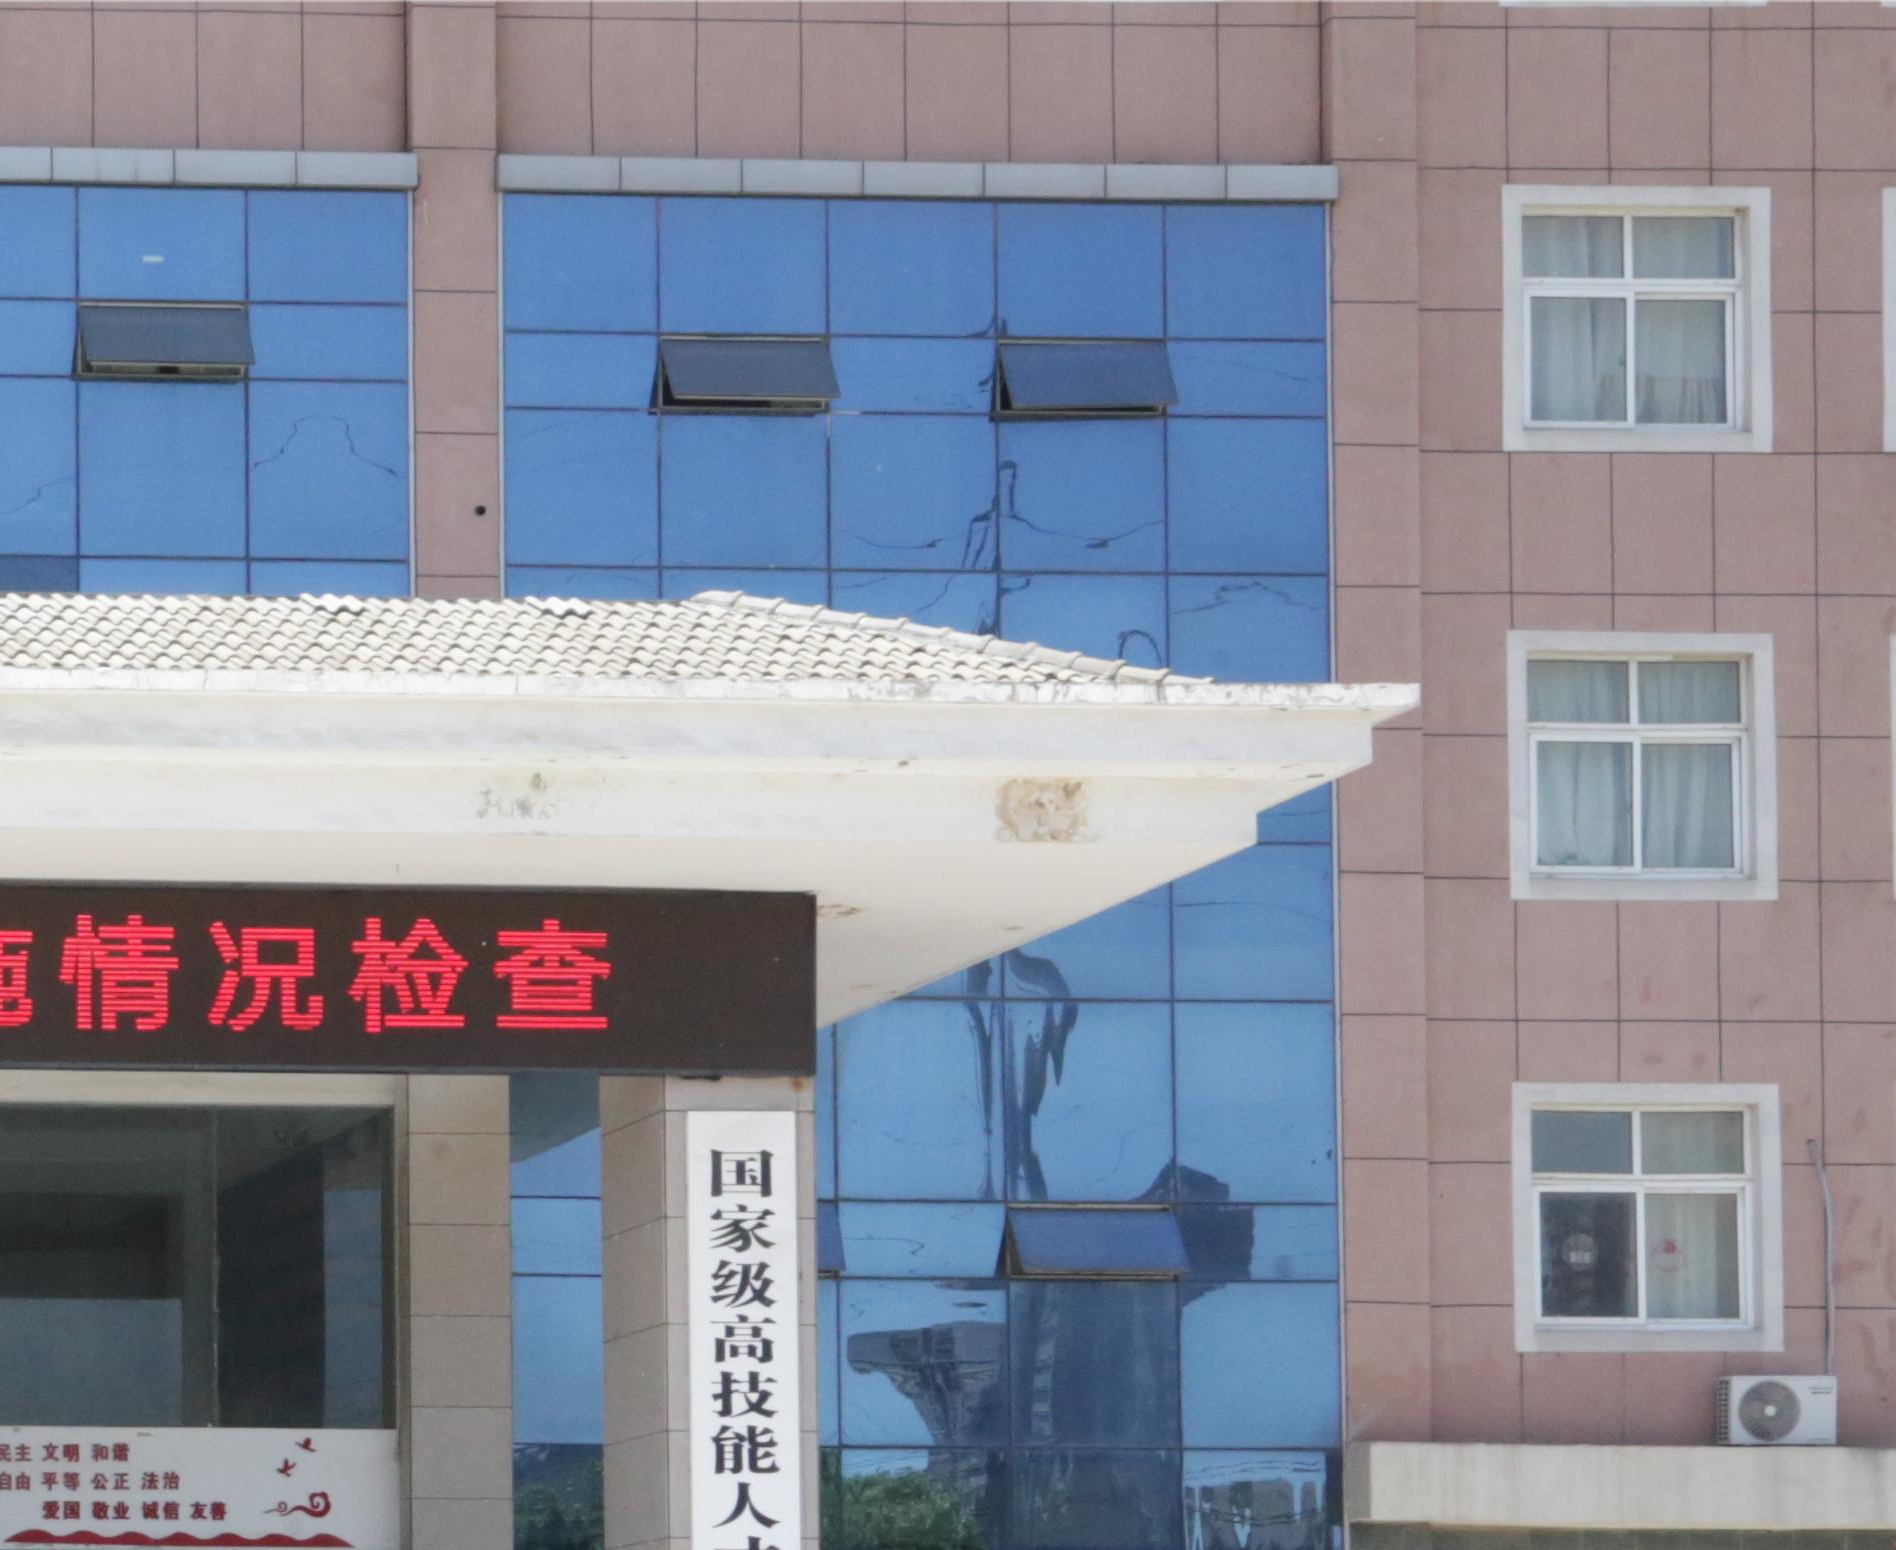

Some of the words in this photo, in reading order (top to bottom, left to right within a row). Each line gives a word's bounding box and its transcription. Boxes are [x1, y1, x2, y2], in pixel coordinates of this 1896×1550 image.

[42, 1443, 81, 1462] 文明
[91, 1443, 130, 1462] 和谐
[41, 1472, 81, 1491] 平等
[91, 1473, 130, 1491] 公正
[141, 1472, 180, 1491] 法治
[42, 1501, 81, 1520] 爱国
[91, 1501, 130, 1520] 敬业
[141, 1501, 180, 1521] 诚信
[190, 1502, 227, 1521] 友善
